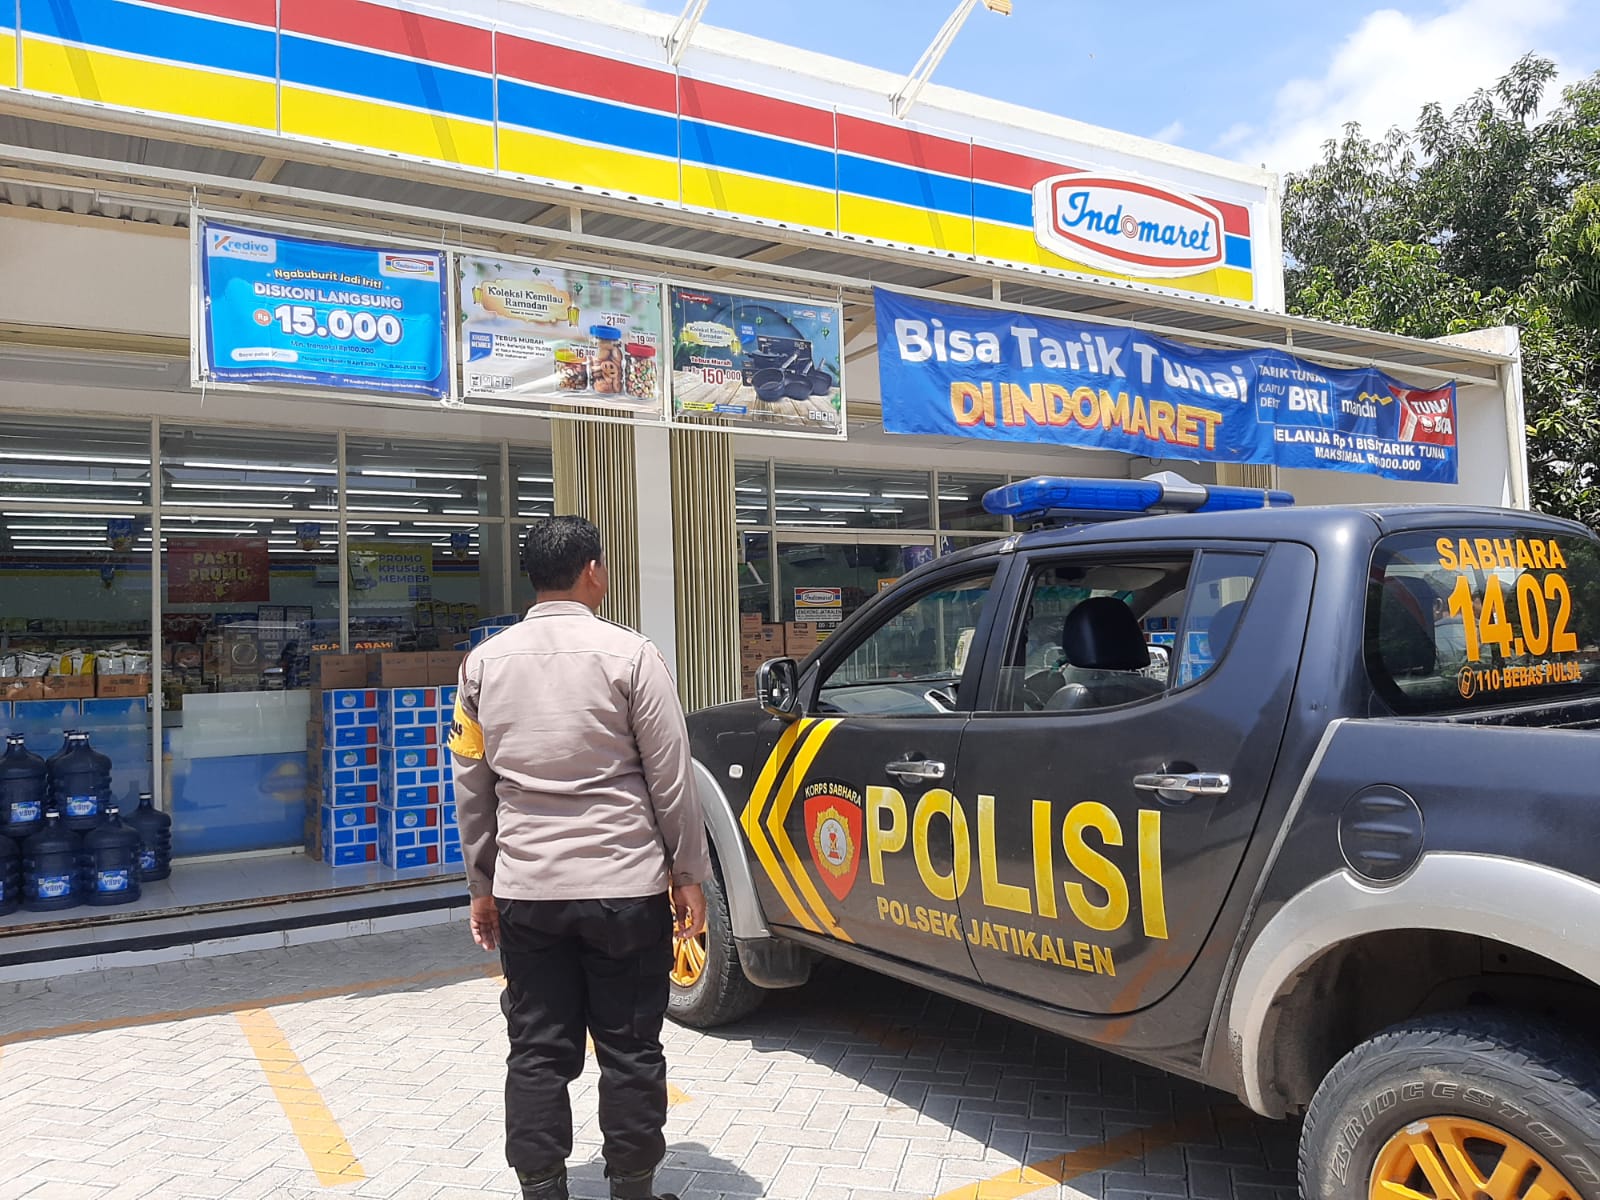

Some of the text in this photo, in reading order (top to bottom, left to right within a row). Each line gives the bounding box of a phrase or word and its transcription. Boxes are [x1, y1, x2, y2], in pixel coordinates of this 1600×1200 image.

[1062, 191, 1211, 251] Indomaret
[213, 234, 269, 252] Kredivo
[274, 269, 382, 289] Ngabuburit Jadi Irit!
[254, 282, 402, 310] DISKON LANGSUNG
[488, 286, 563, 304] Koleksi Kemilau
[505, 297, 548, 310] Ramadan
[257, 304, 402, 344] Rp 15.000
[495, 334, 545, 346] TEBUS MURAH
[691, 356, 710, 364] Tebus
[894, 318, 1248, 403] Bisa Tarik Tunai
[1288, 385, 1329, 415] BRI
[951, 381, 1223, 452] DI INDOMARET
[1273, 427, 1331, 446] ELANJA
[1333, 434, 1346, 450] Rp
[1315, 446, 1366, 464] MAKSIMAL
[193, 551, 243, 565] PASTI
[379, 554, 423, 563] PROMO
[1435, 537, 1568, 571] SABHARA
[188, 566, 249, 581] PROMO
[379, 564, 426, 573] KHUSUS
[379, 575, 430, 583] MEMBER
[1447, 572, 1579, 663] 14.02
[1476, 660, 1583, 692] 110 BEBAS PULSA
[805, 783, 862, 806] KORPS SABHARA
[865, 785, 1168, 939] POLISI
[876, 895, 1117, 977] POLSEK JATIKALEN
[1330, 1081, 1600, 1200] BRIDGESTON
